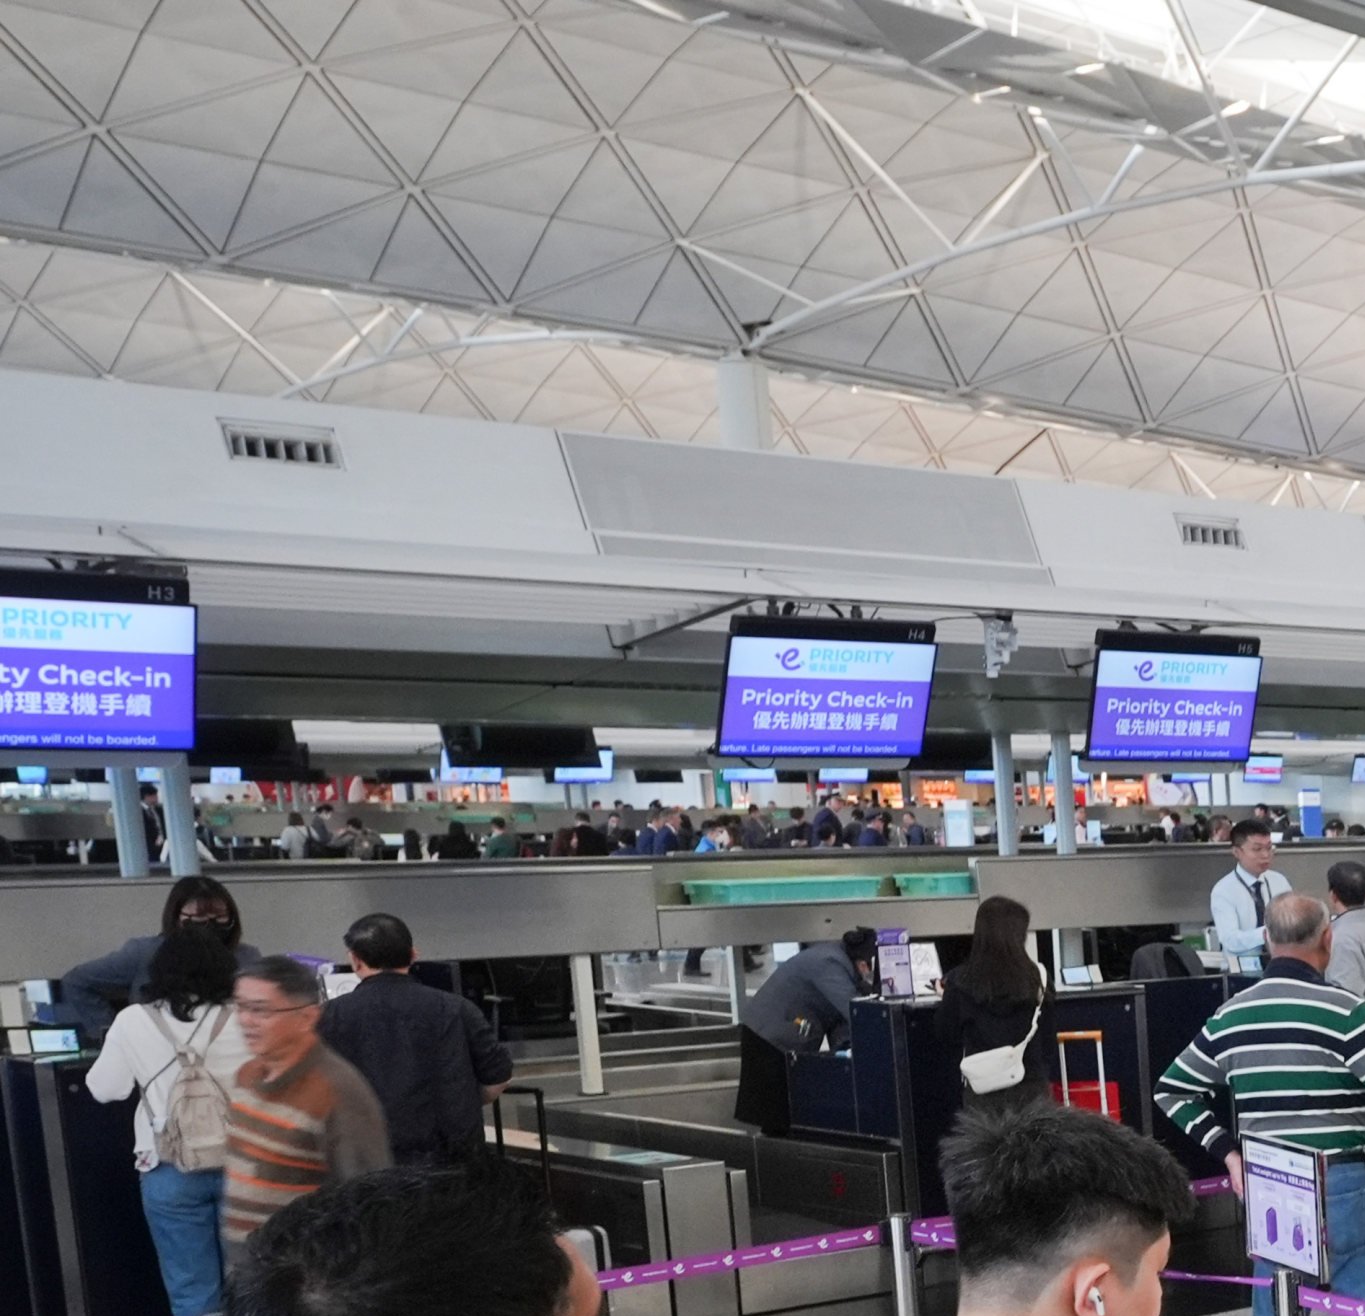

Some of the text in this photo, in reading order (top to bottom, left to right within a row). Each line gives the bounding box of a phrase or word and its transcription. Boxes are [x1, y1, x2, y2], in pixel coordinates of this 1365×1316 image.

[148, 585, 175, 600] H3
[2, 607, 132, 630] PRIORITY
[908, 628, 925, 640] H4
[810, 647, 894, 665] PRIORITY
[38, 664, 171, 688] Check-in
[1160, 661, 1228, 676] PRIORITY
[742, 689, 914, 710] Priority Check-in
[1107, 698, 1243, 718] Priority Check-in
[753, 711, 898, 731] 優先辦理登機手續
[41, 733, 61, 744] will
[65, 734, 85, 745] not
[88, 734, 104, 745] be
[751, 744, 770, 753] Late
[772, 745, 820, 754] passengers
[822, 745, 835, 753] will
[837, 745, 850, 753] not
[852, 745, 863, 753] be
